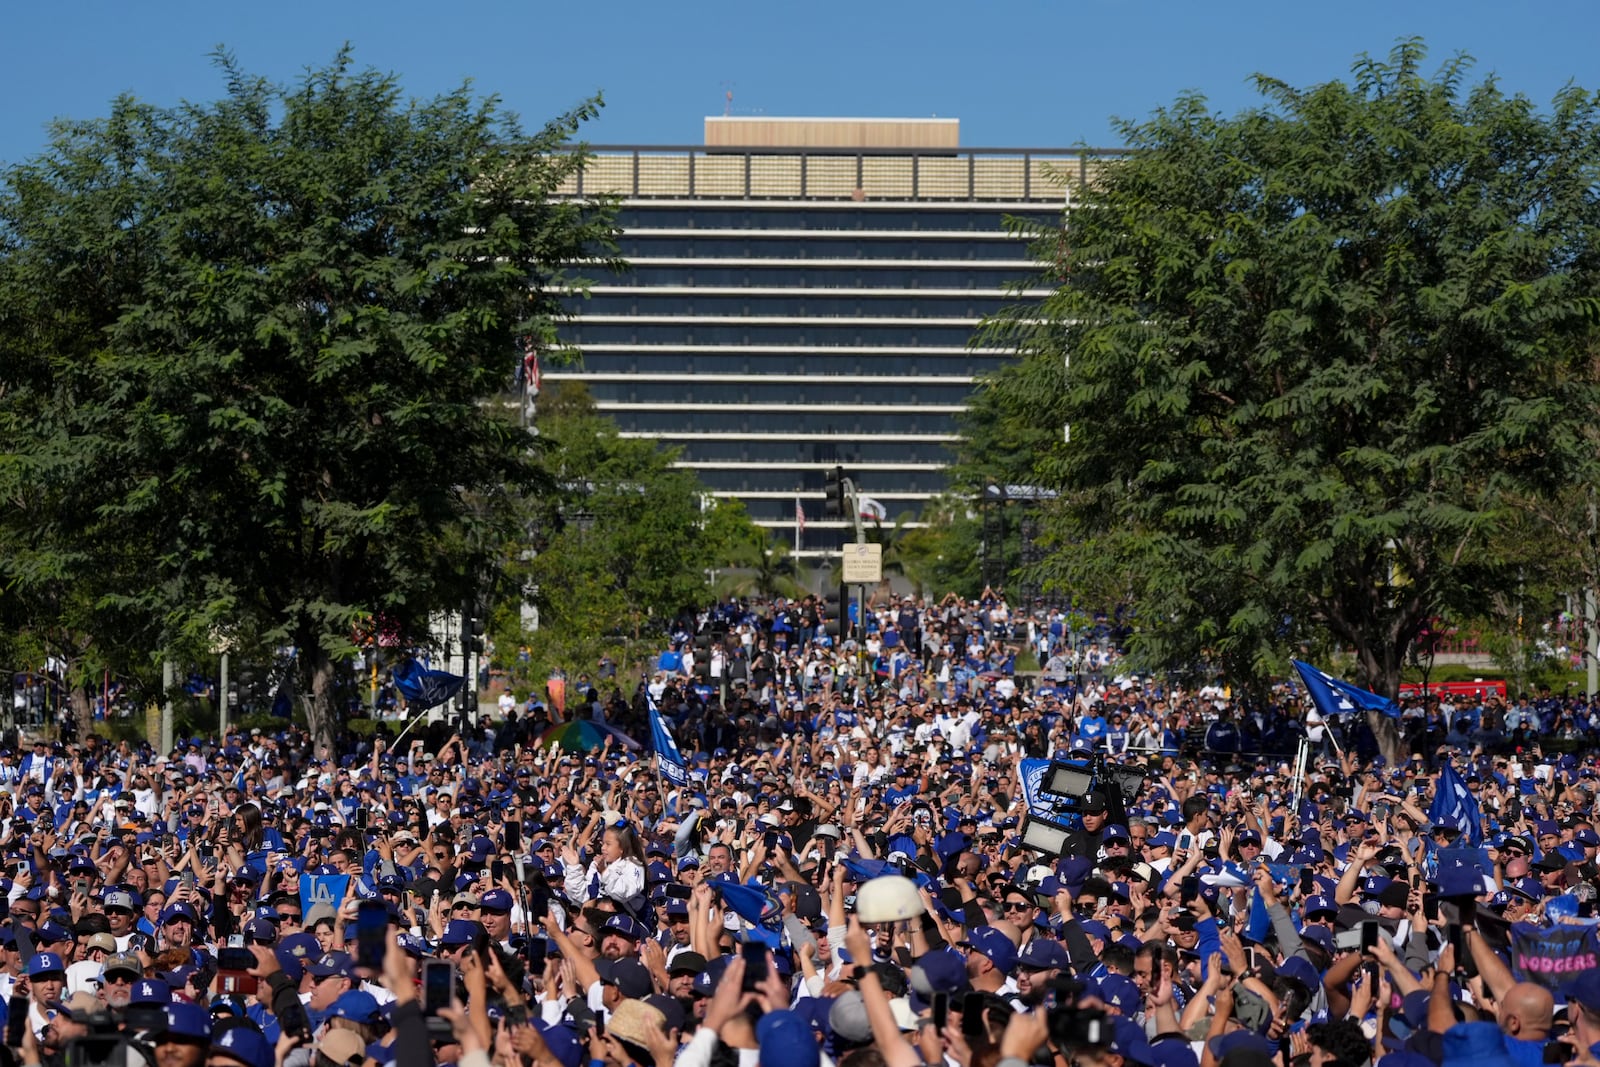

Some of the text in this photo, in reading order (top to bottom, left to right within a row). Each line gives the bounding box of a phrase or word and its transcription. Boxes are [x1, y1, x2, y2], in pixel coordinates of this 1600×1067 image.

[1368, 878, 1375, 888] LA
[308, 875, 335, 904] LA
[1319, 897, 1327, 906] LA
[1501, 892, 1507, 901] LA
[612, 916, 620, 925] LA
[397, 936, 406, 946] LA
[41, 955, 51, 968] B
[1519, 952, 1597, 973] DODGERS
[703, 972, 710, 984] LA
[142, 982, 152, 996] LA
